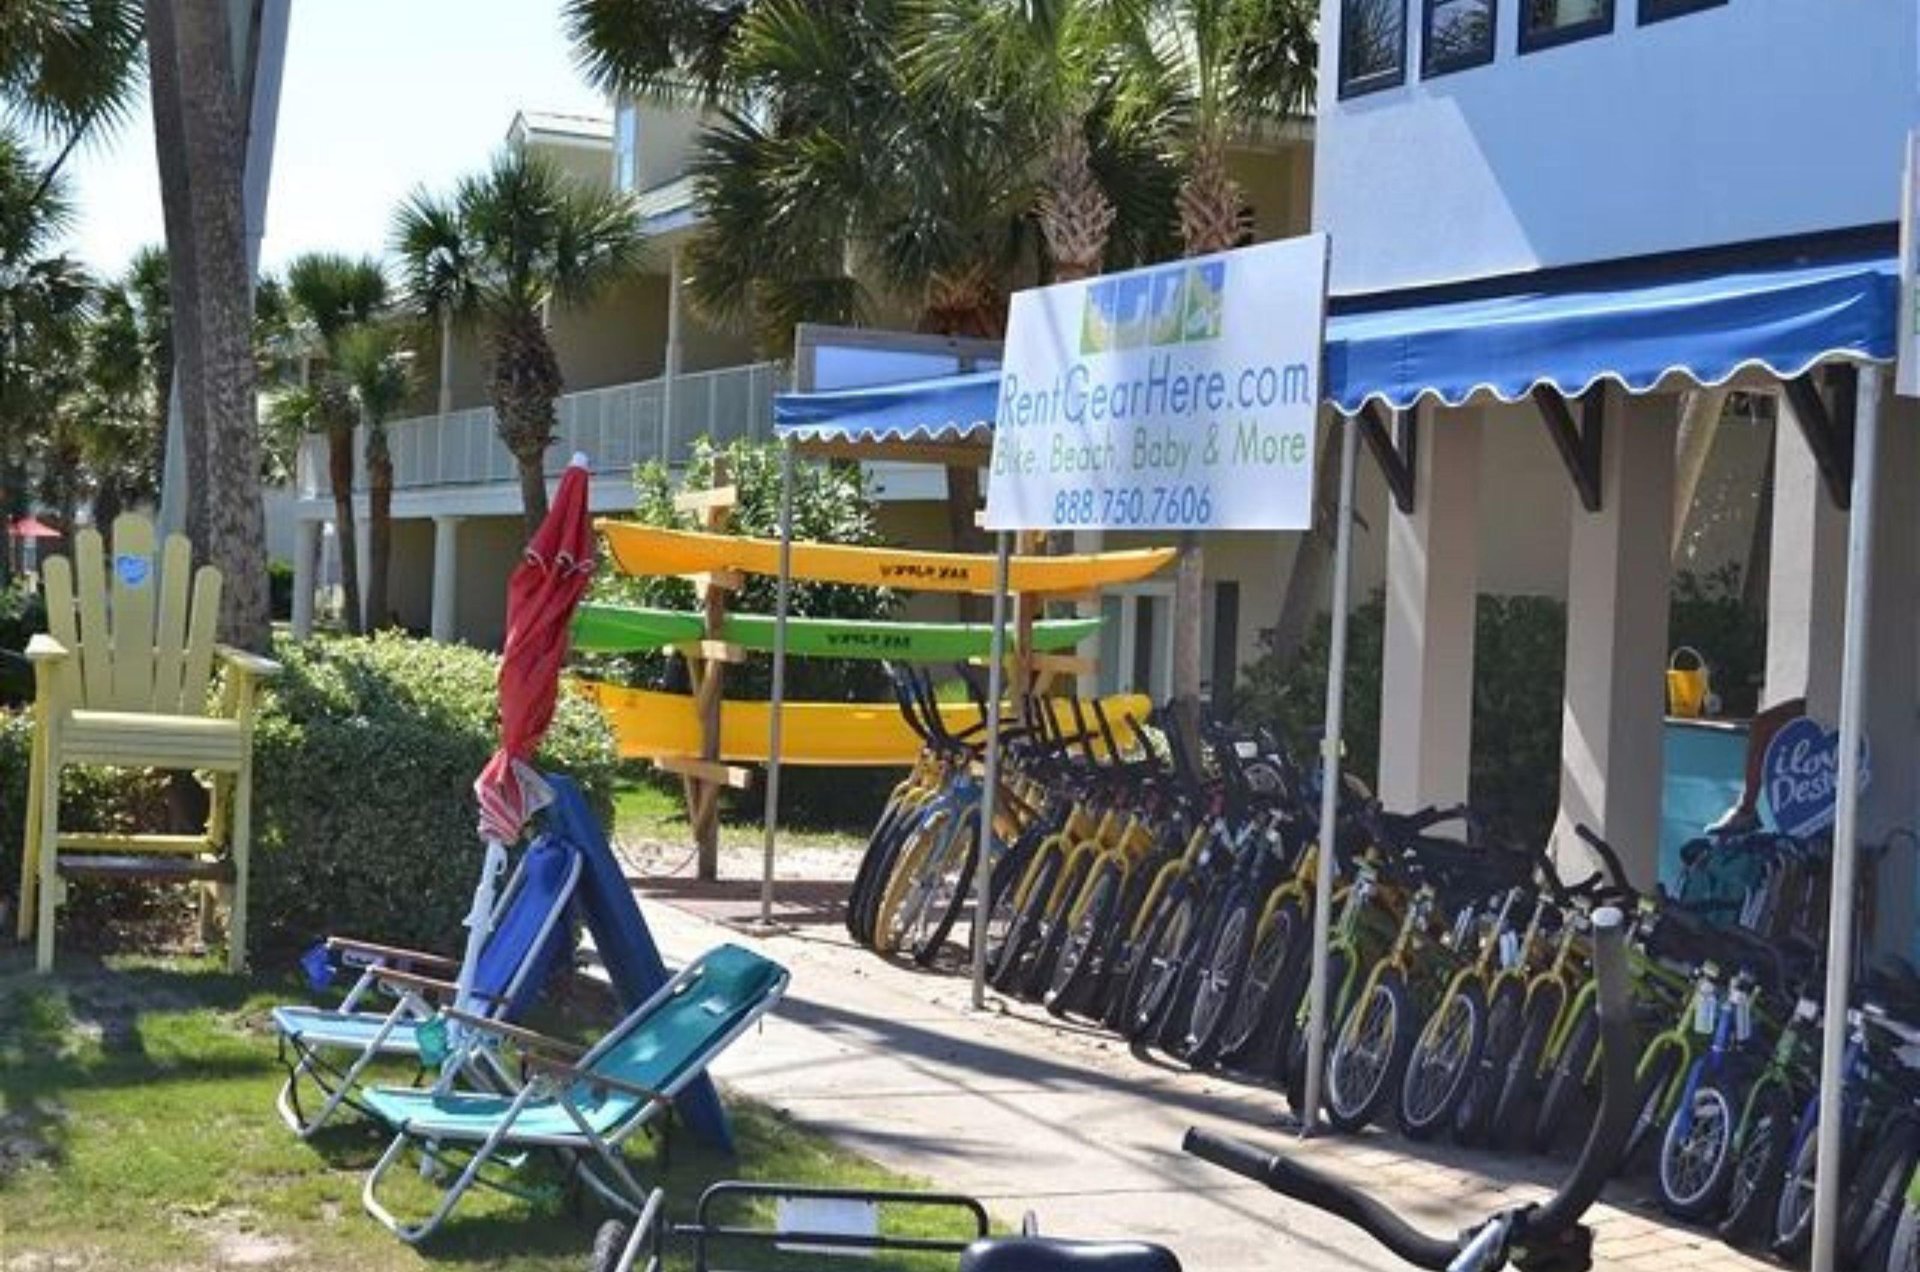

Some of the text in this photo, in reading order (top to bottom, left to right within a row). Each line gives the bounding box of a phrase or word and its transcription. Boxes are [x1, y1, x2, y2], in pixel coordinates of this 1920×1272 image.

[999, 353, 1310, 428] RentGearHere.com
[1132, 426, 1192, 478] Baby
[1202, 422, 1219, 465] &
[1232, 418, 1306, 465] More
[1054, 484, 1211, 524] 888.750.7606
[1790, 739, 1839, 775] lov
[1772, 767, 1838, 813] Dest
